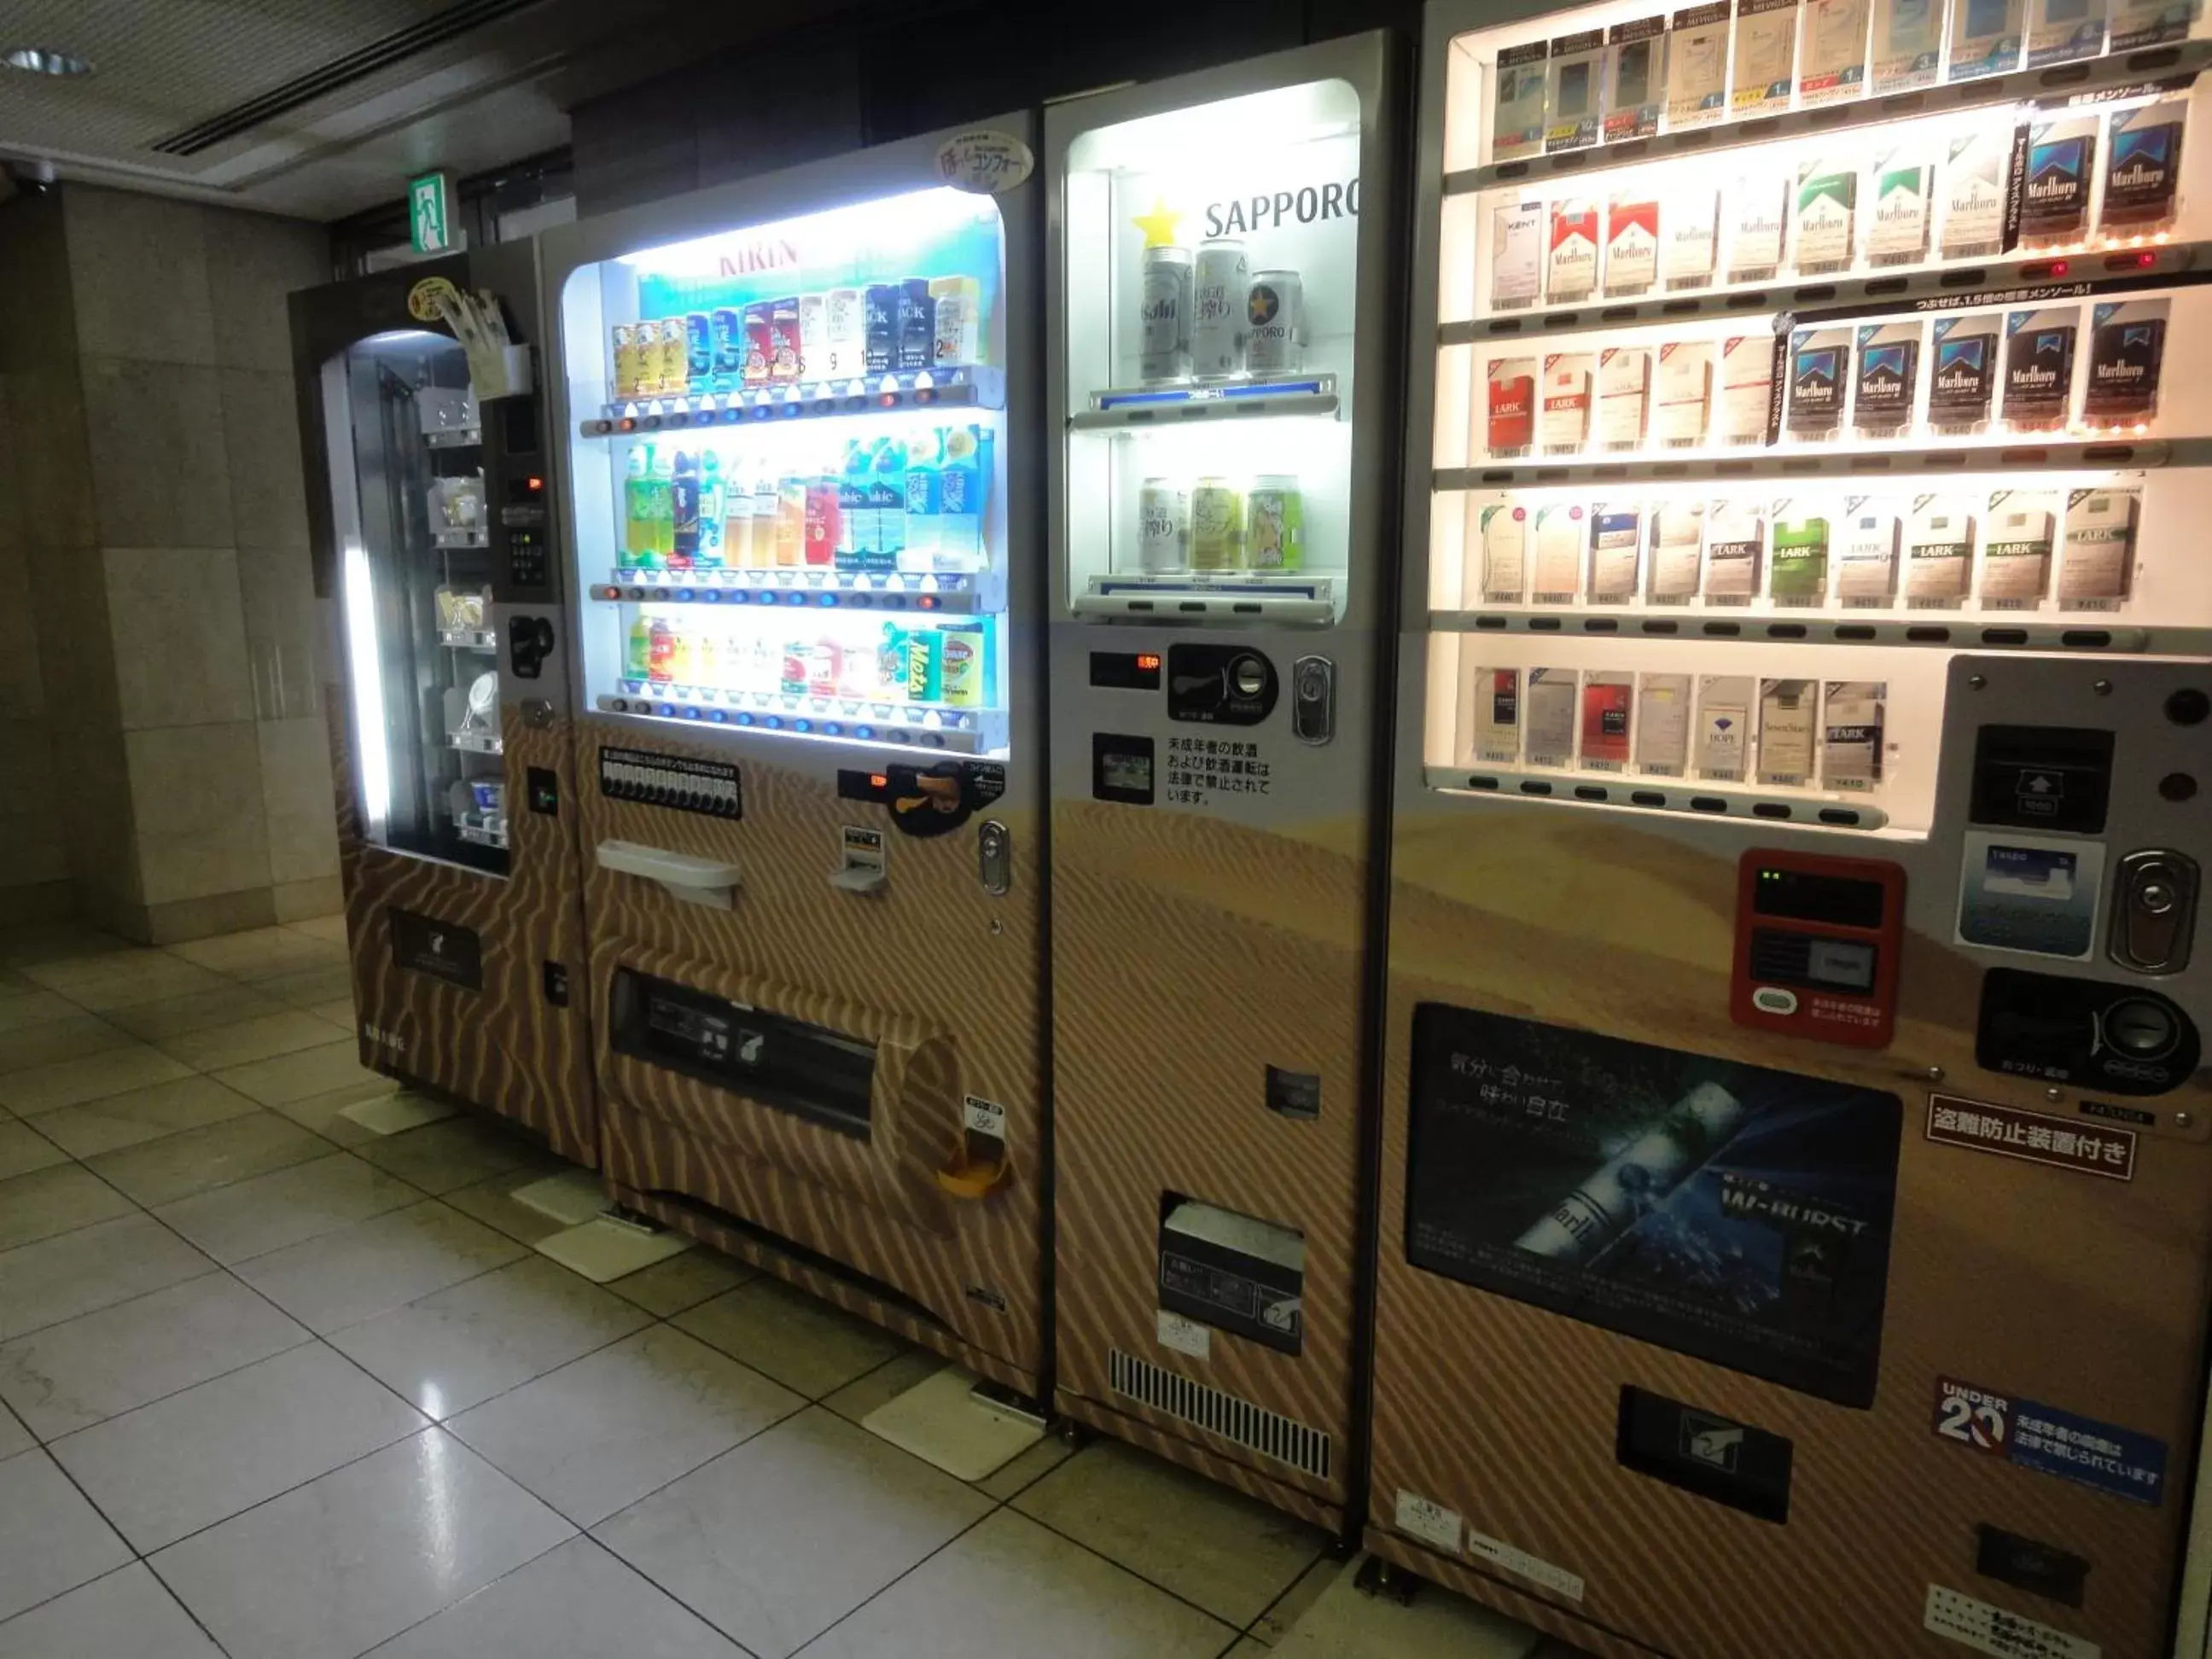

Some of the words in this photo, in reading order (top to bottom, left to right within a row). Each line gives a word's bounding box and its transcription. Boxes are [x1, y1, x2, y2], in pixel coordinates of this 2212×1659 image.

[2111, 164, 2165, 187] Marlboro
[2028, 177, 2077, 200] Marlboro
[1877, 202, 1919, 221] Marlboro
[1951, 192, 1997, 212] Marlboro
[1508, 219, 1536, 231] KENT
[2012, 364, 2057, 385] Marlboro
[2098, 358, 2145, 379] Marlboro
[1796, 381, 1833, 399] Marlboro
[1862, 374, 1901, 395] Marlboro
[1938, 370, 1980, 390] Marlboro
[1494, 402, 1520, 414] LARK
[1551, 398, 1577, 410] LARK
[2076, 528, 2114, 542] LARK
[1717, 544, 1747, 556] LARK
[1780, 545, 1811, 559] LARK
[1920, 544, 1954, 558] LARK
[1996, 542, 2031, 556] LARK
[910, 641, 929, 694] Mets
[1709, 733, 1737, 744] HOPE
[1835, 729, 1865, 740] LARK
[1167, 736, 1258, 758] 未成年者の飲酒
[1167, 755, 1270, 777] および飲酒運転は
[1167, 771, 1270, 795] 法律で禁止されて
[1167, 790, 1209, 806] います。
[1934, 1107, 2127, 1165] 盗難防止装置付き
[1942, 1382, 2009, 1412] UNDER
[1938, 1395, 2005, 1449] 20
[2016, 1414, 2123, 1458] 未成年者の喫煙は
[2014, 1432, 2160, 1487] 法律で禁じられています
